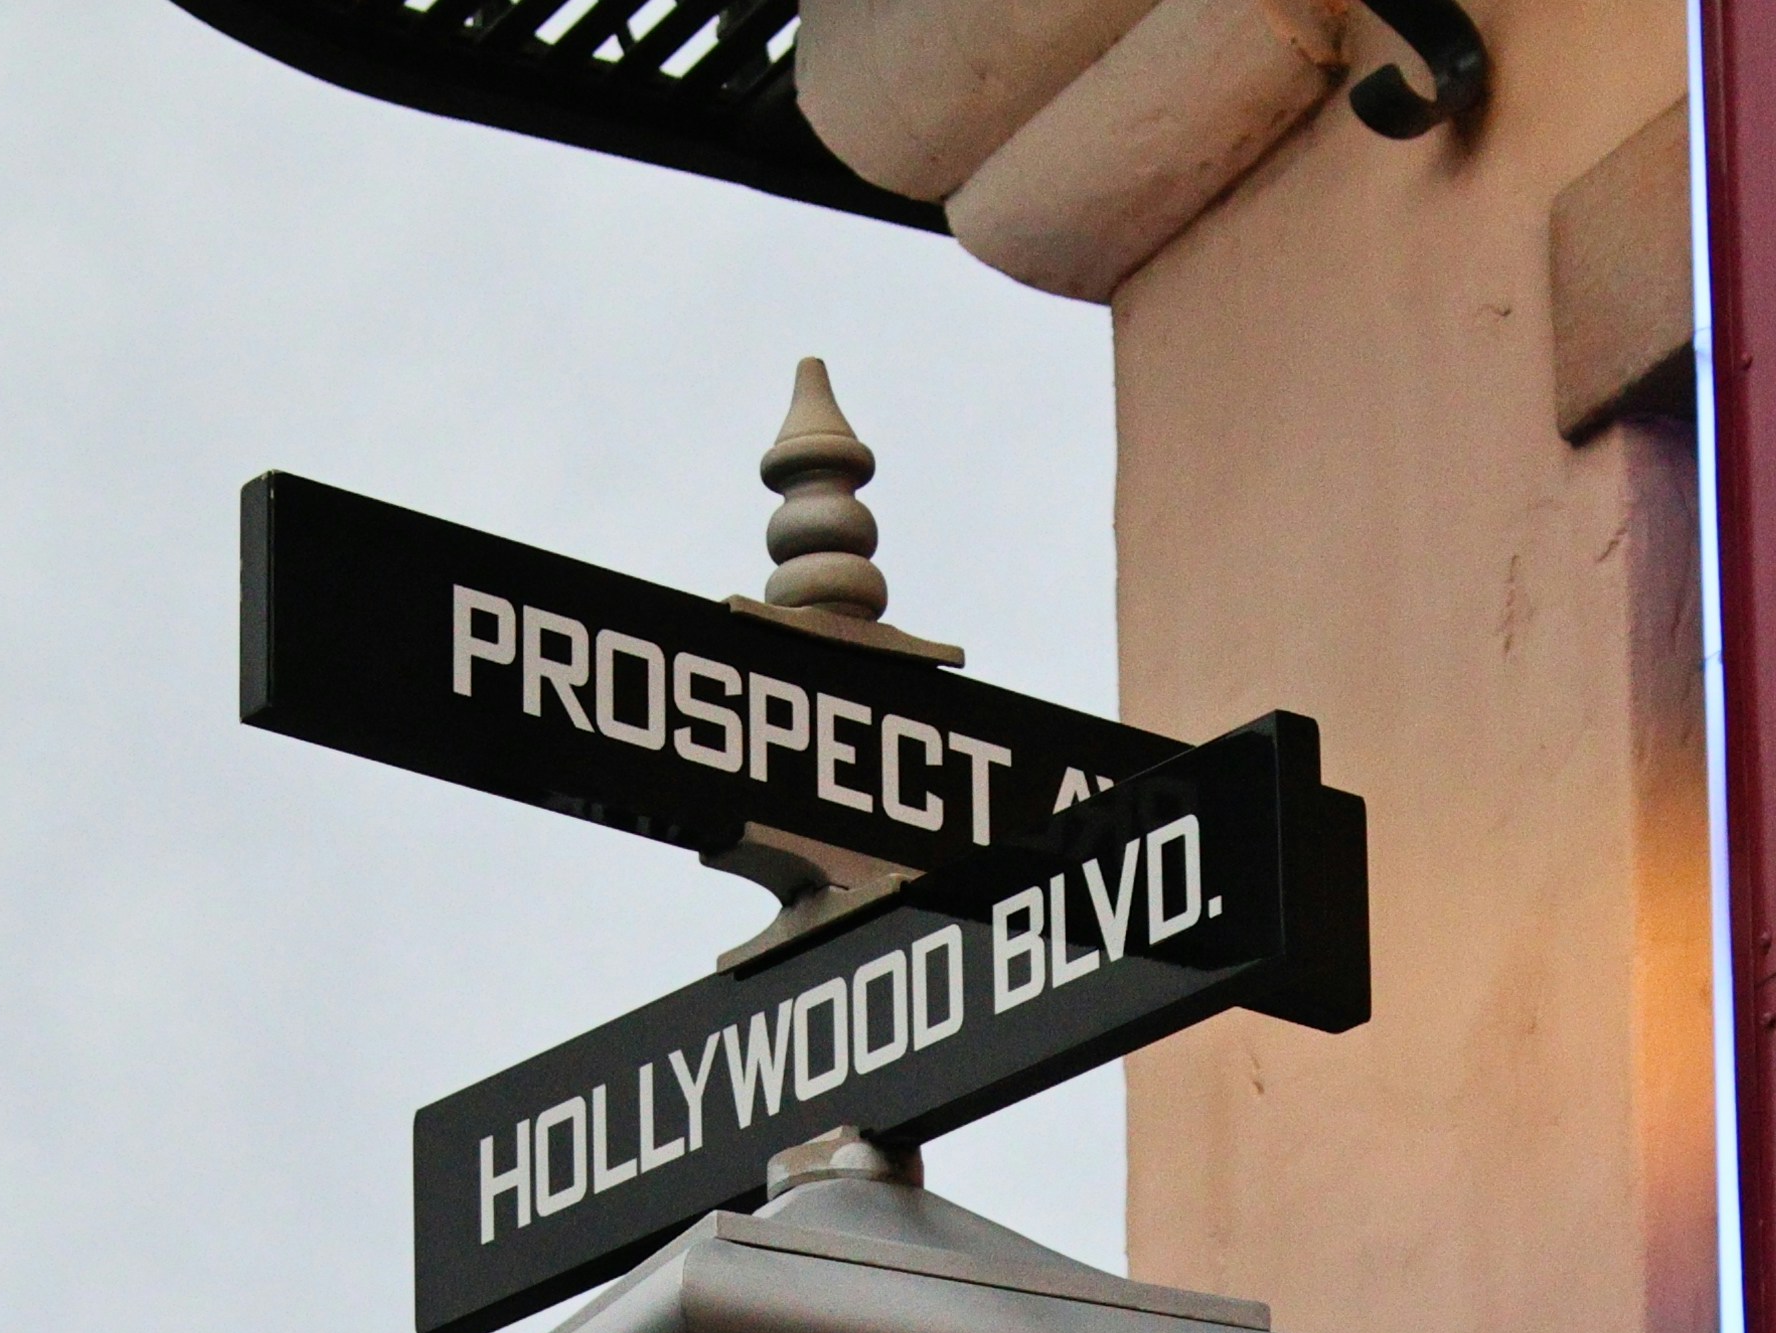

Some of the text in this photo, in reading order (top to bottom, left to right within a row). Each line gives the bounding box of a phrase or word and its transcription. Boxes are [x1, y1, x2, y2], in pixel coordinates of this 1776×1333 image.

[452, 583, 1012, 847] PROSPECT
[479, 813, 1224, 1246] HOLLYWOOD BLVD.
